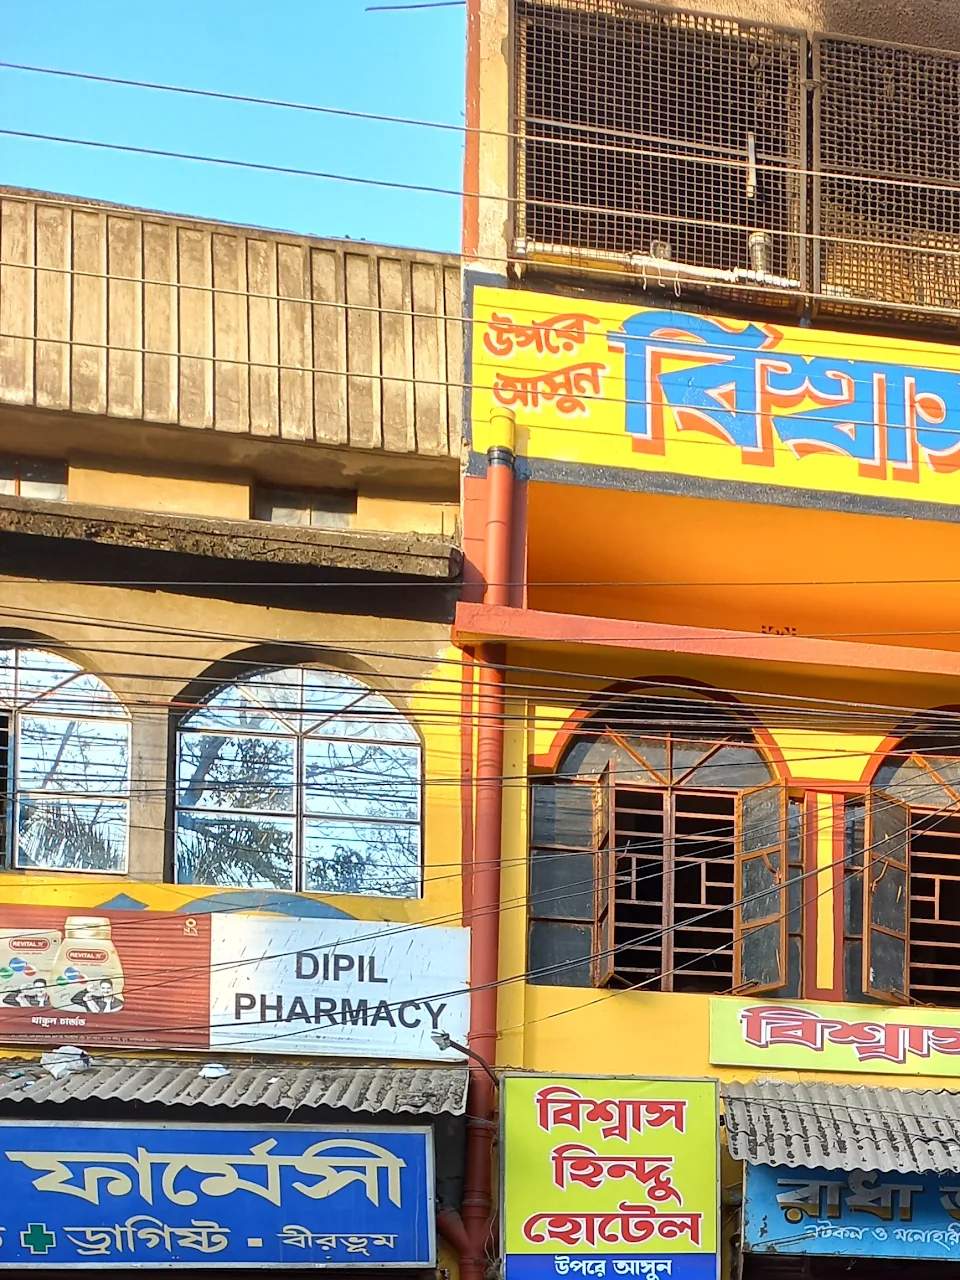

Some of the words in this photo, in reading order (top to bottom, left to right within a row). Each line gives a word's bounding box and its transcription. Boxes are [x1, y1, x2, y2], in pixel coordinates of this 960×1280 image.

[484, 313, 602, 355] উপরে
[493, 362, 606, 414] আসুন
[296, 953, 388, 984] DIPIL
[235, 993, 447, 1030] PHARMACY
[536, 1087, 686, 1141] বিশ্বাস
[5, 1138, 407, 1208] ফার্মেসী
[552, 1144, 682, 1206] হিন্দু
[777, 1170, 924, 1224] রাধা
[277, 1224, 399, 1255] বীরভূম
[524, 1202, 702, 1246] হোটেল
[871, 1227, 888, 1241] ও
[555, 1255, 607, 1276] উপরে
